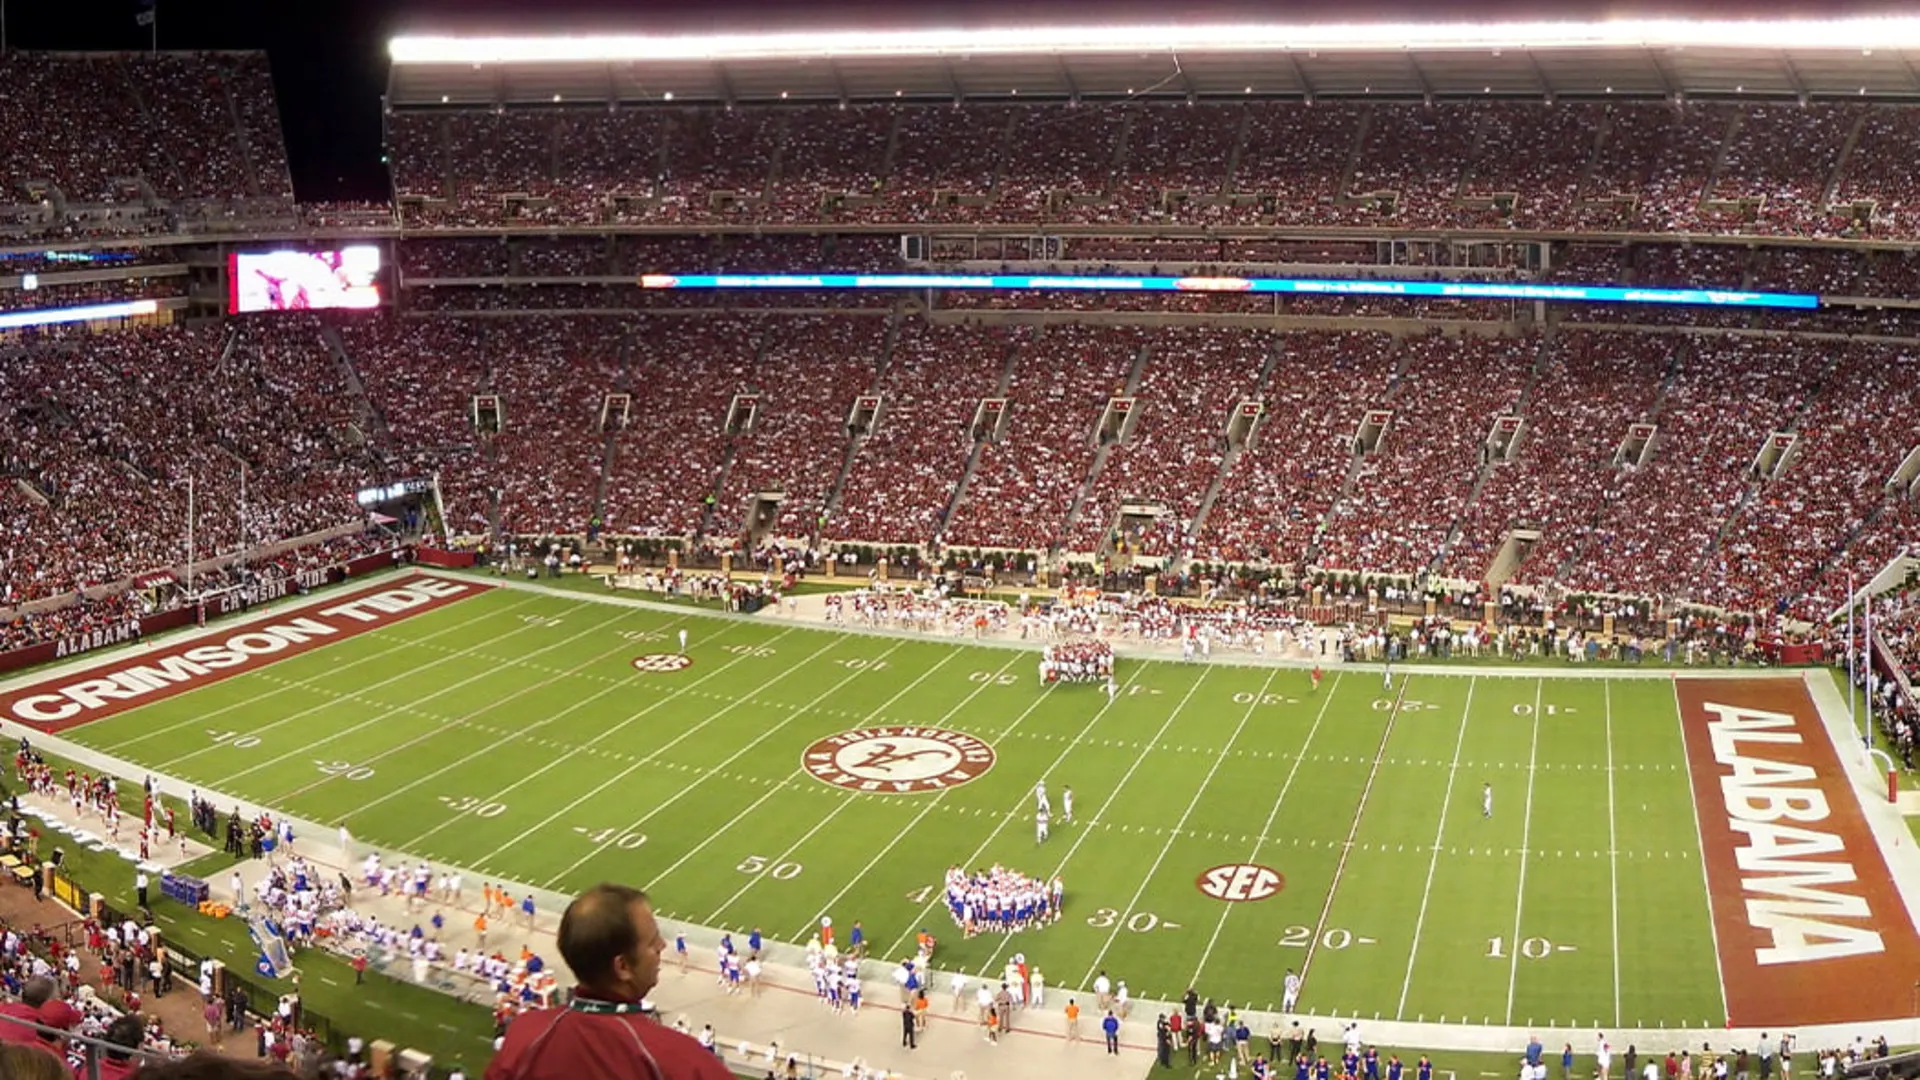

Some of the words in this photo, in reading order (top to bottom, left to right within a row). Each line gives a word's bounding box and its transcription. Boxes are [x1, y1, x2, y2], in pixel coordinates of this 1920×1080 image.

[220, 581, 288, 612] CRMSON
[12, 617, 338, 722] CRIMSON
[319, 578, 469, 623] TIDE
[56, 621, 132, 658] ALABAM
[210, 731, 262, 749] 10
[317, 760, 376, 781] 20
[806, 752, 971, 792] ALABAMA
[447, 796, 507, 818] 30
[587, 827, 648, 850] 40
[1703, 702, 1886, 966] ALABAMA
[735, 855, 803, 880] 50
[906, 884, 935, 904] 4
[1200, 865, 1281, 900] SEC
[1086, 907, 1158, 933] 30
[1278, 925, 1351, 950] 20
[1484, 936, 1552, 959] 10
